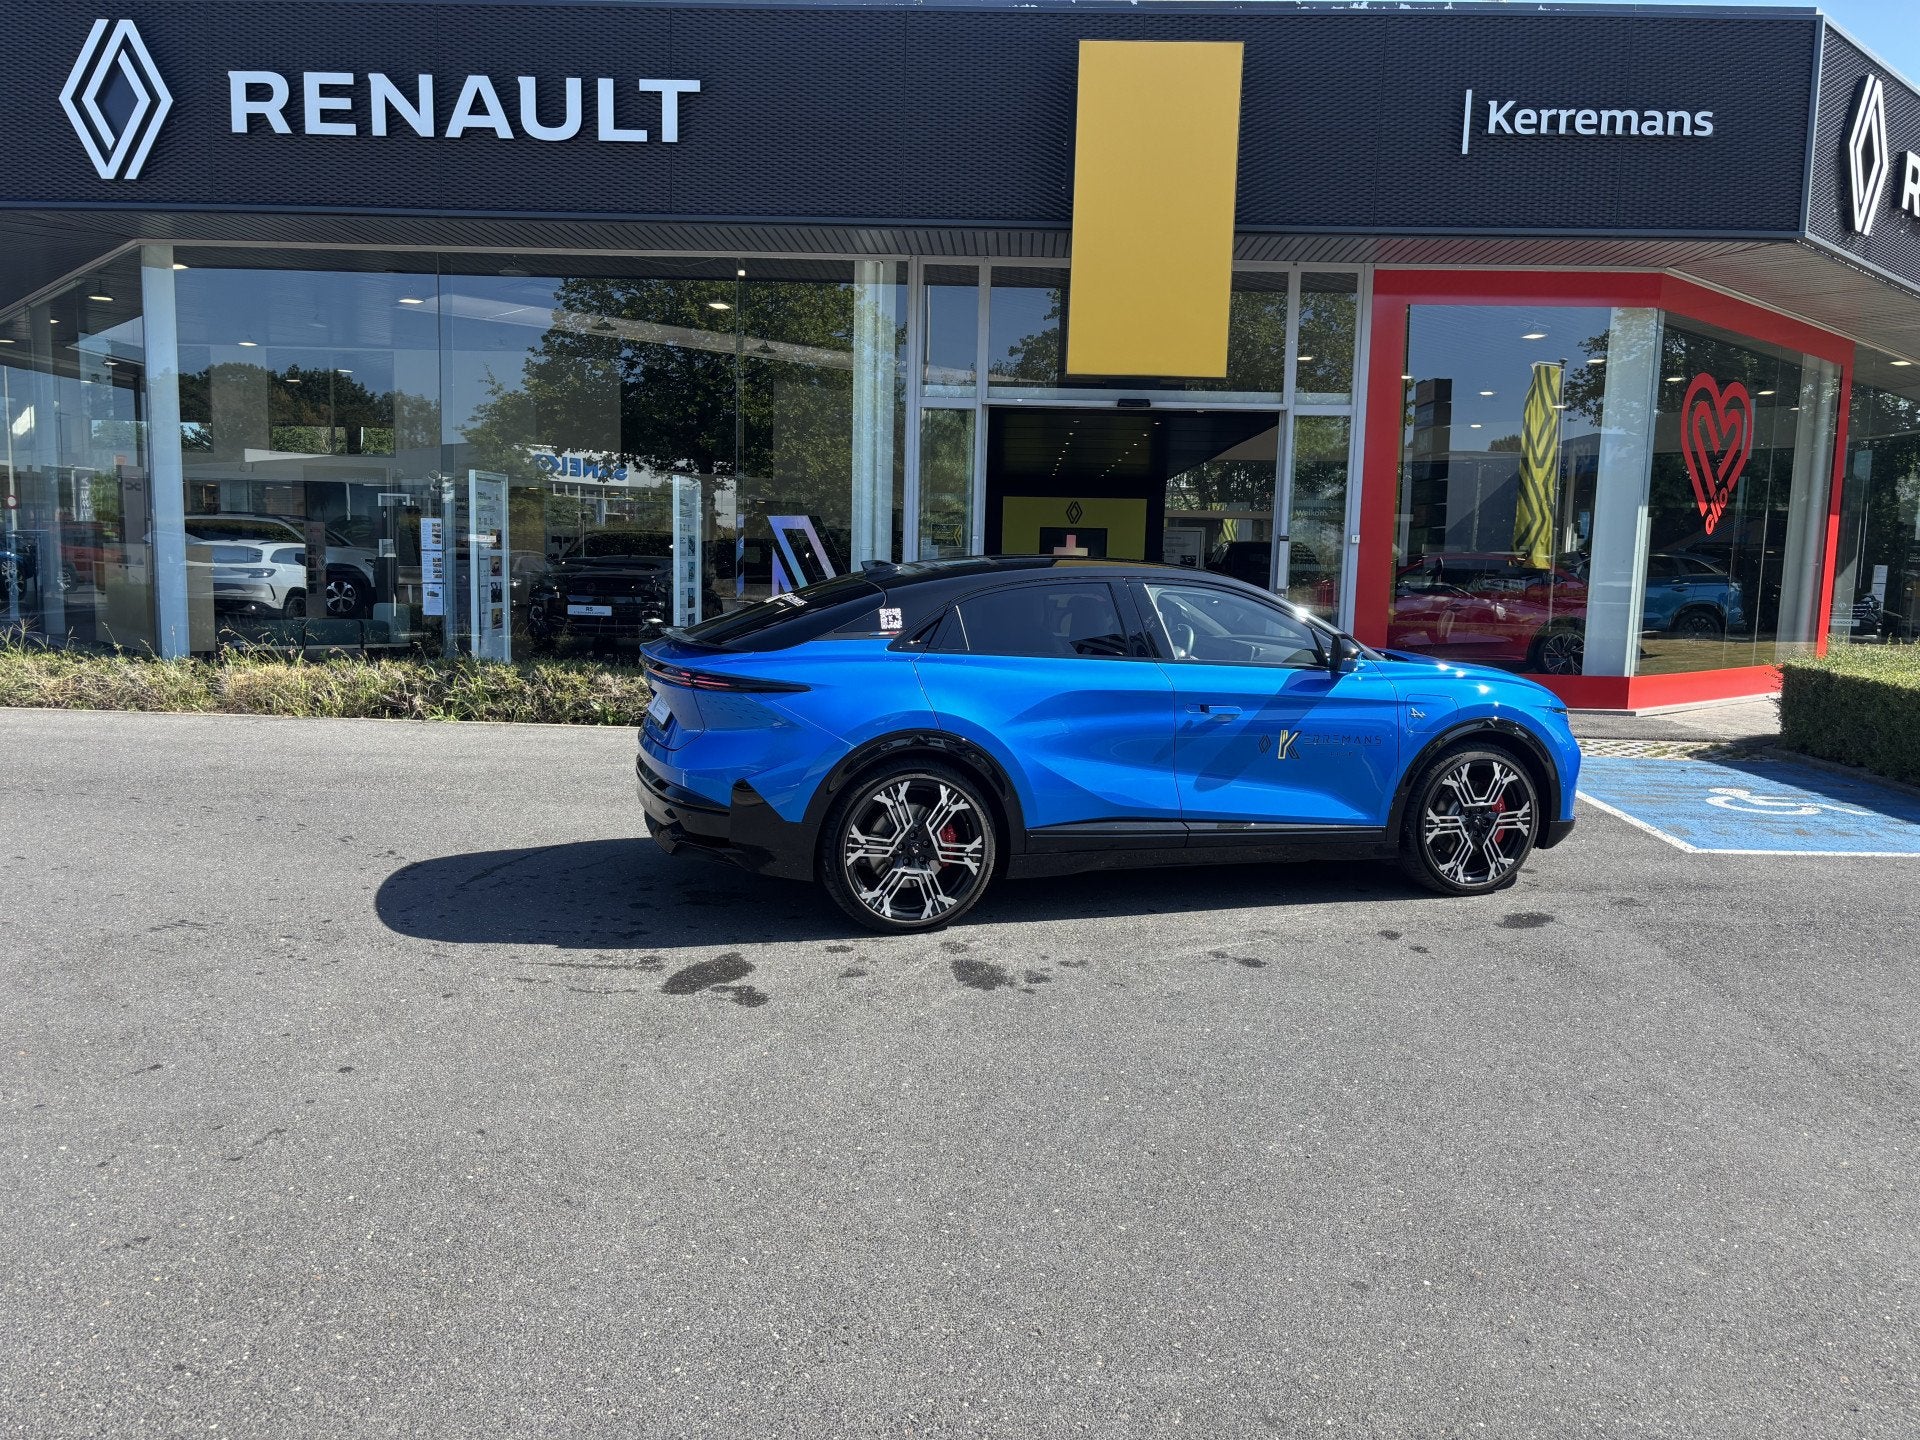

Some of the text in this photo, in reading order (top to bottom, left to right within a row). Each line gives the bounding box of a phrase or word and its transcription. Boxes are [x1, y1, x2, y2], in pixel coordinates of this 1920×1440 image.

[228, 70, 701, 143] RENAULT
[1488, 100, 1714, 137] Kerremans
[1705, 488, 1728, 535] clio
